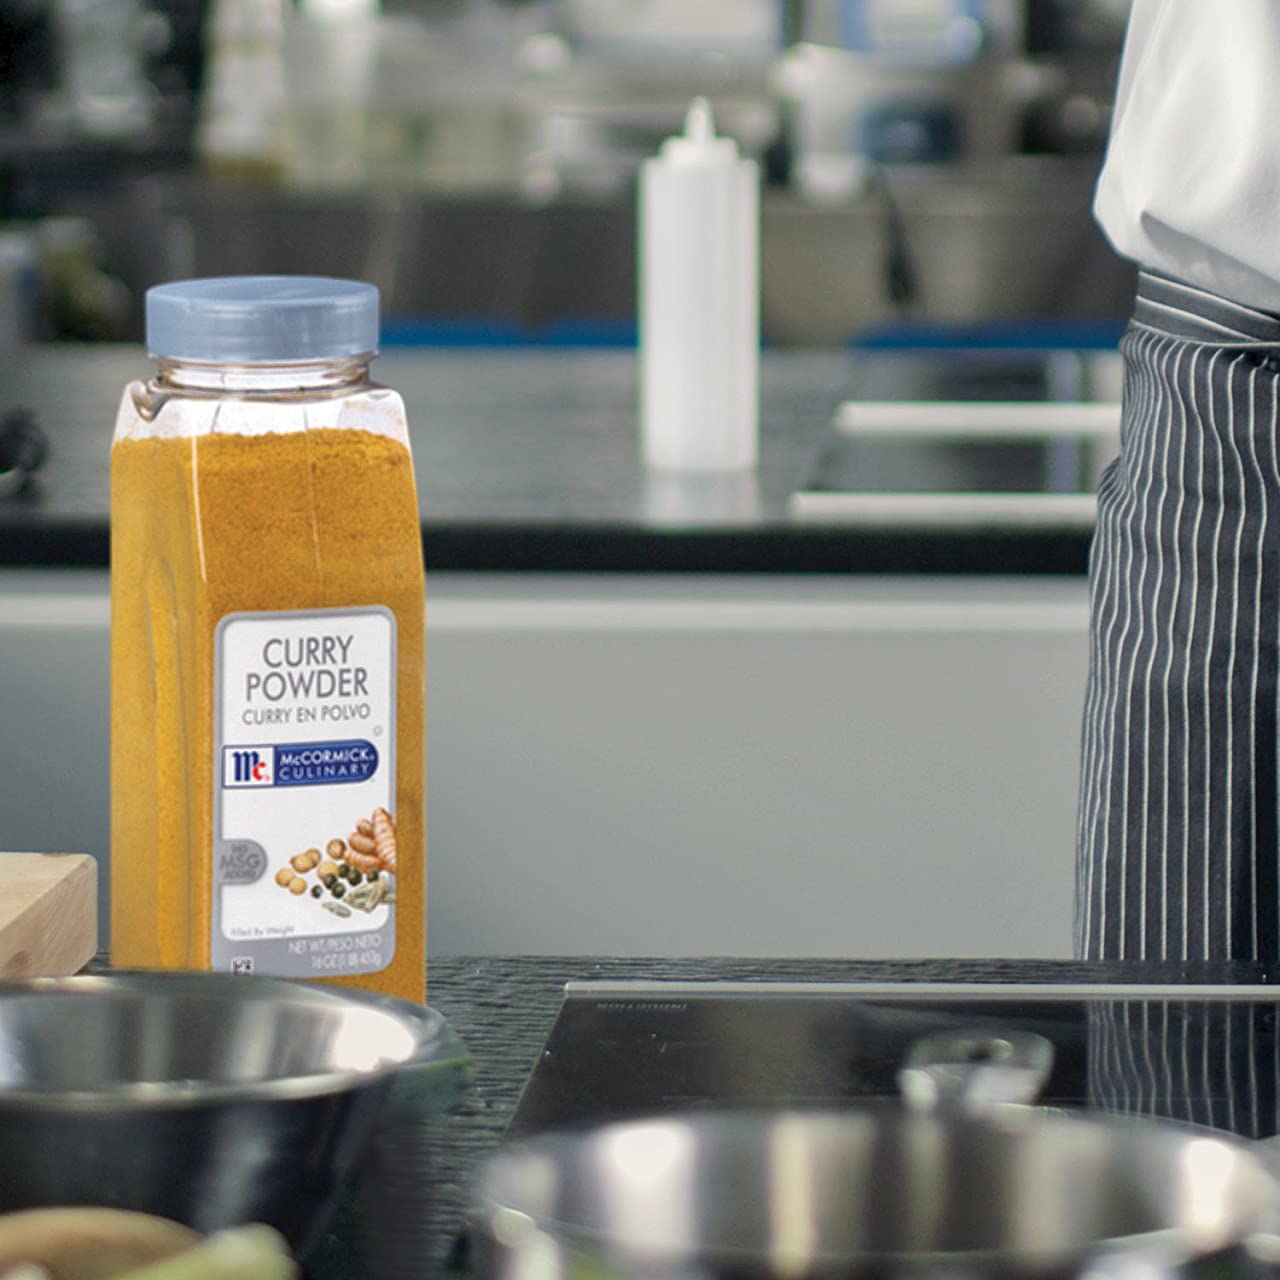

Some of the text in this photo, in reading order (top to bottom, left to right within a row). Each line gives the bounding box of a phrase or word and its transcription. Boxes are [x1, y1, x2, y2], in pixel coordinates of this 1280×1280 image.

[263, 635, 354, 668] CURRY
[246, 667, 369, 702] POWDER
[242, 702, 371, 726] CURRY EN POLVO
[279, 763, 370, 780] CULINARY
[219, 853, 260, 870] MSG
